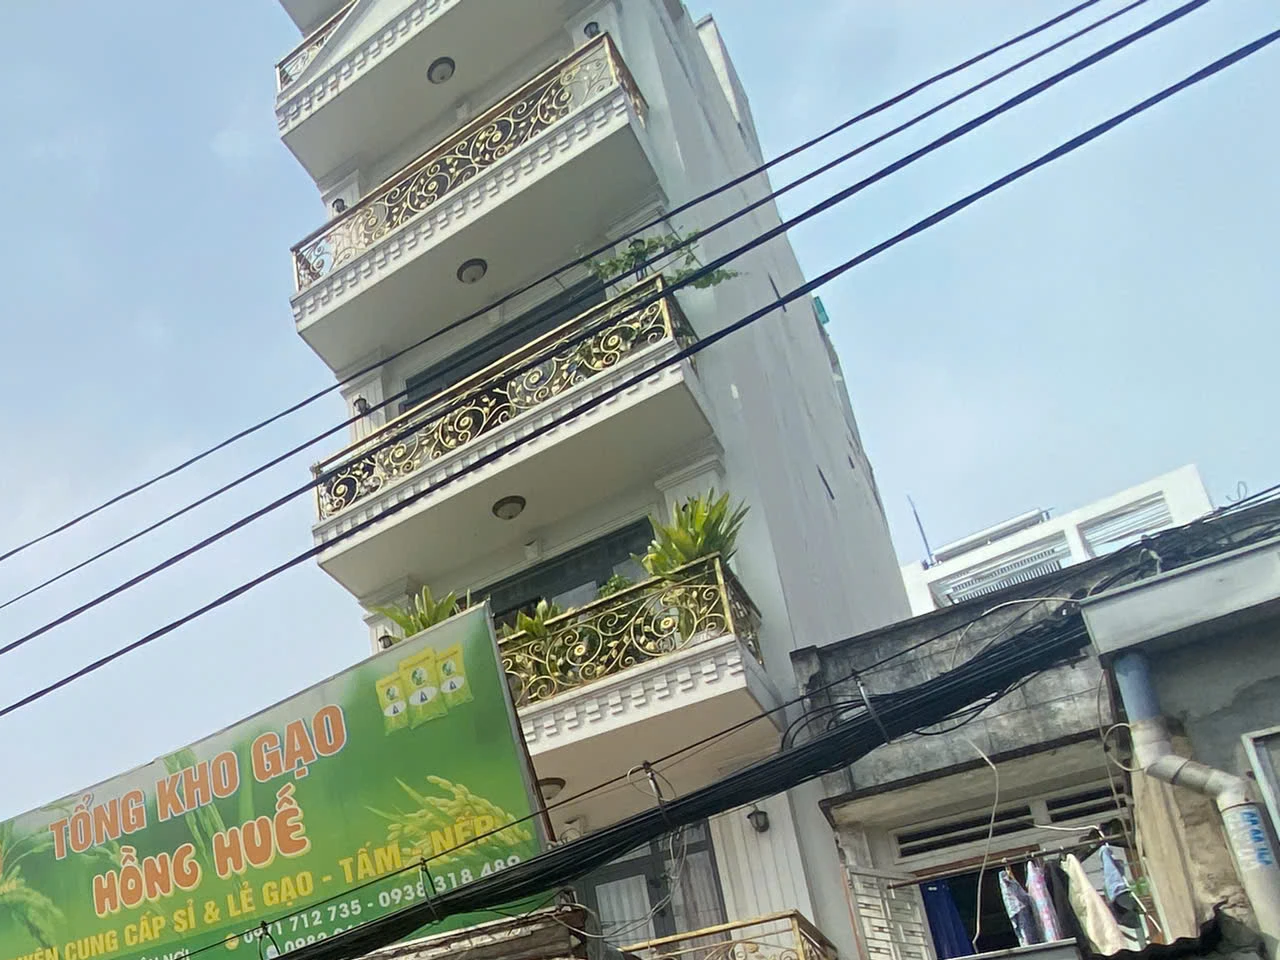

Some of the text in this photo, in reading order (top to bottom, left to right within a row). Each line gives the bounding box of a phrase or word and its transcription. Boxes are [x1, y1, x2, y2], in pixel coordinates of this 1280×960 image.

[49, 704, 347, 860] TỔNG KHO GẠO
[92, 782, 311, 918] HỒNG HUẾ
[289, 910, 322, 931] 712
[327, 899, 362, 921] 735
[434, 868, 473, 892] 318
[124, 910, 166, 946] CẤP
[203, 900, 220, 923] &
[227, 880, 256, 917] LẺ
[262, 870, 314, 907] GẠO
